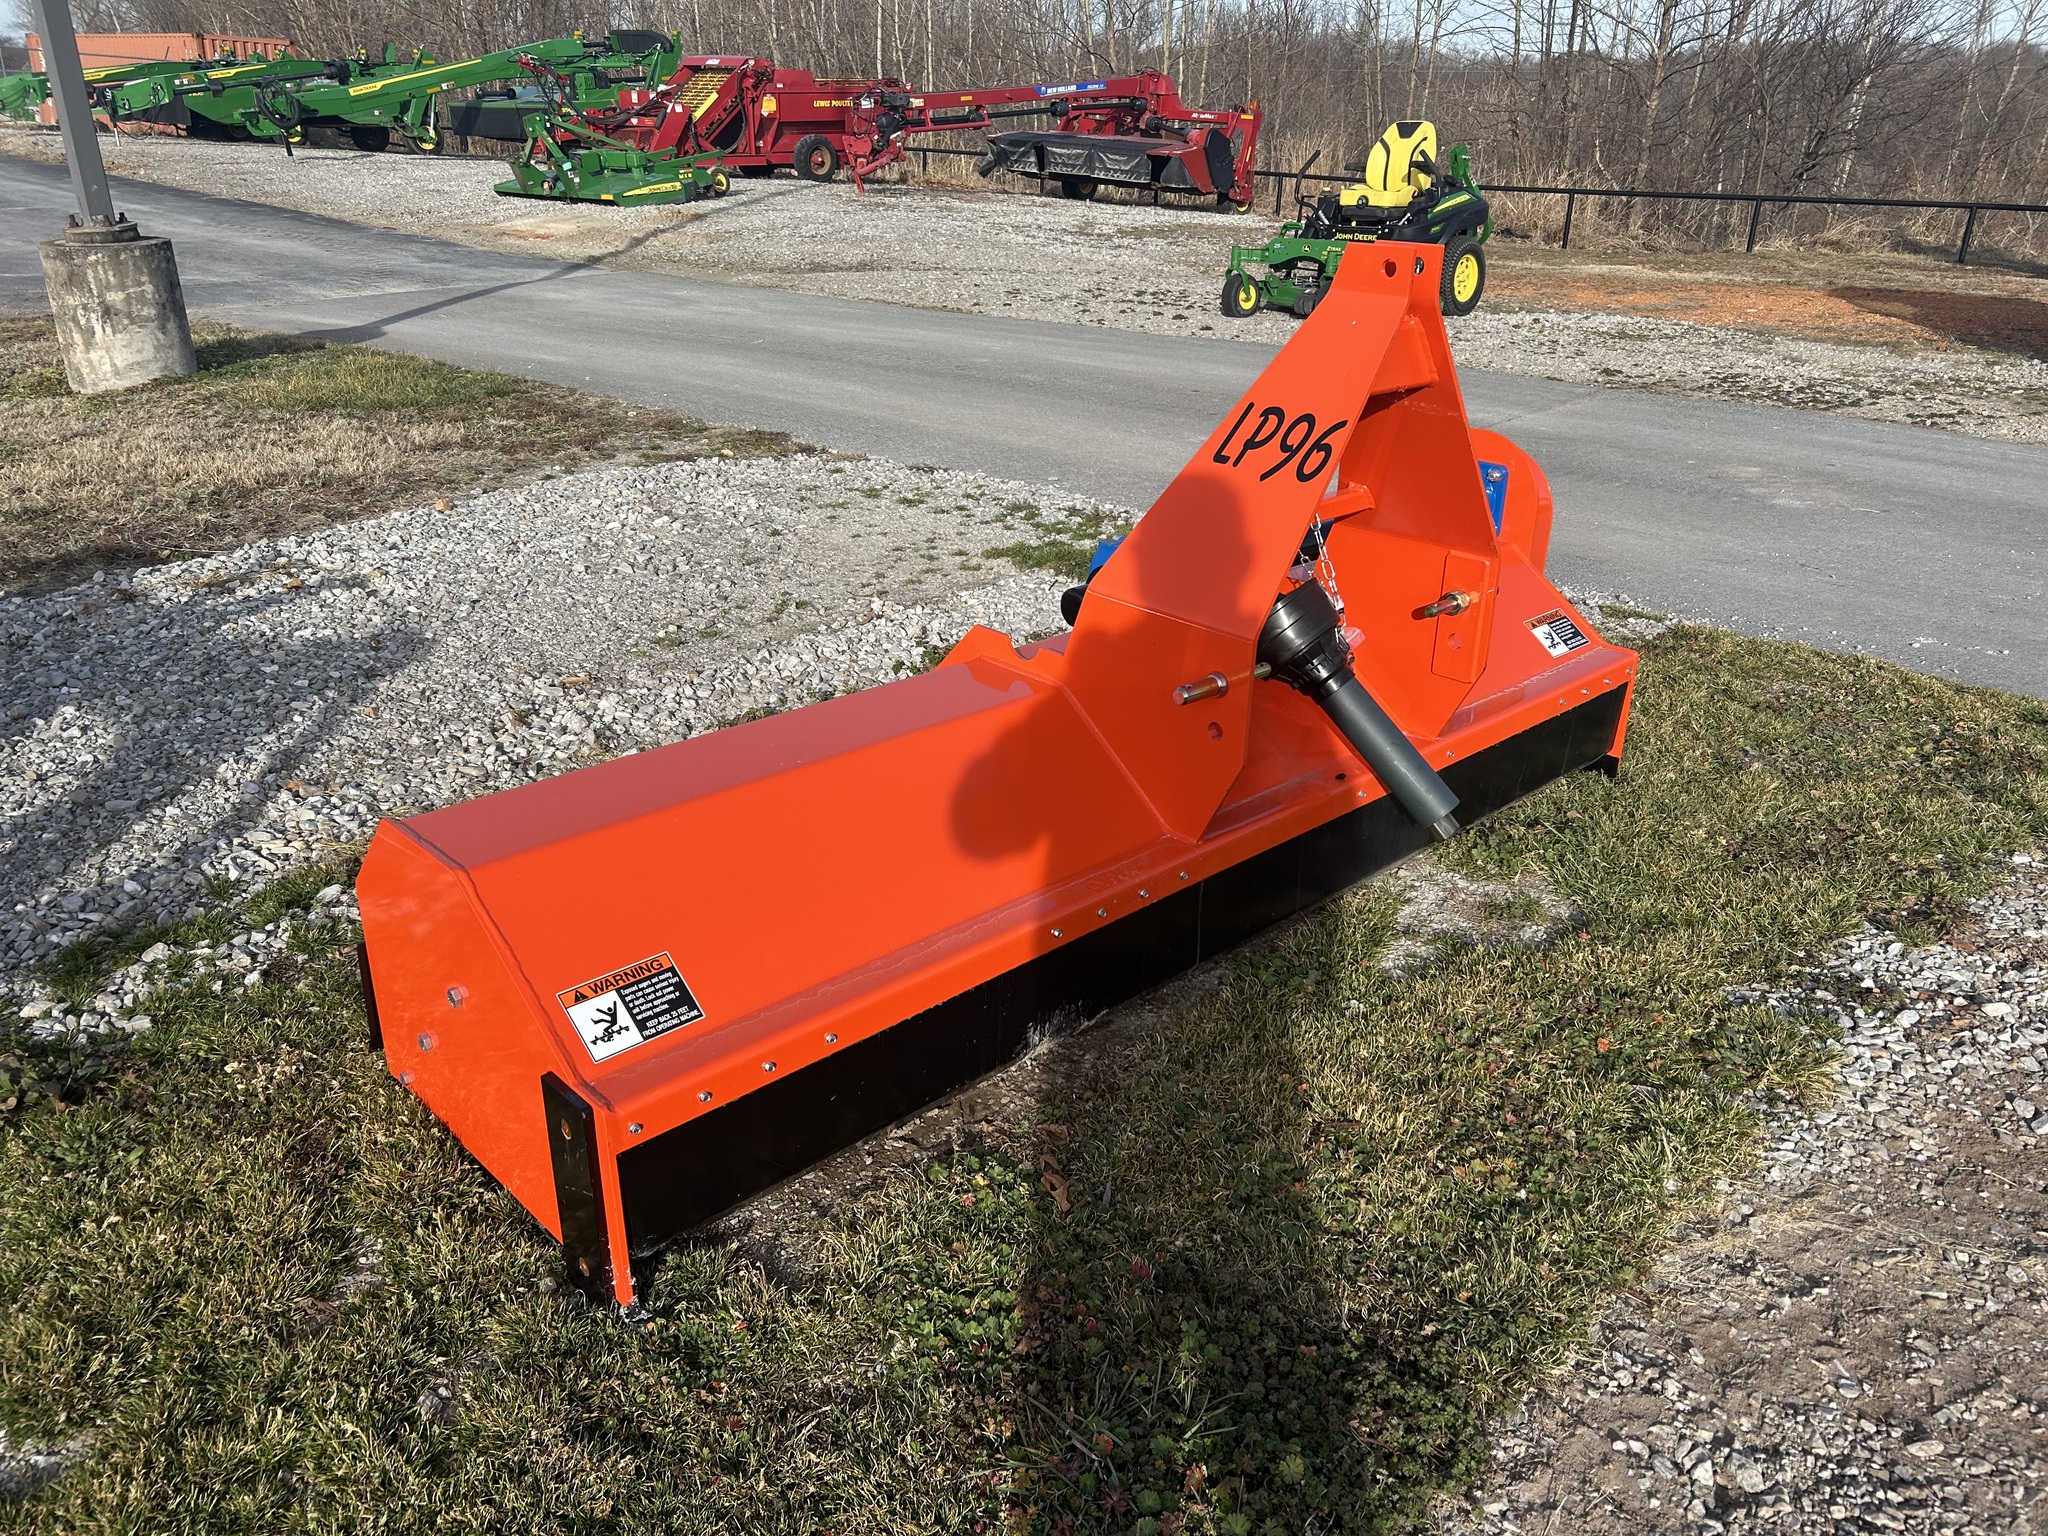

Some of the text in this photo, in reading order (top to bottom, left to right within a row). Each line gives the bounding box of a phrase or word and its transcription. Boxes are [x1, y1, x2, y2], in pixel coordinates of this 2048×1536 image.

[1334, 232, 1378, 241] JOHN DEERE
[1213, 402, 1348, 482] LP96
[587, 959, 664, 995] WARNING
[621, 984, 638, 996] Exposed
[658, 971, 673, 981] moving
[625, 994, 636, 1002] parts
[655, 981, 668, 989] serious
[668, 976, 680, 984] injury
[662, 986, 675, 994] power
[640, 1002, 653, 1010] before
[653, 993, 676, 1006] approaching
[635, 1010, 653, 1021] servicing
[646, 1019, 659, 1027] KEEP
[658, 1014, 672, 1022] BACK
[677, 1006, 689, 1014] FEET
[643, 1028, 656, 1037] FROM
[656, 1018, 680, 1031] OPERATING
